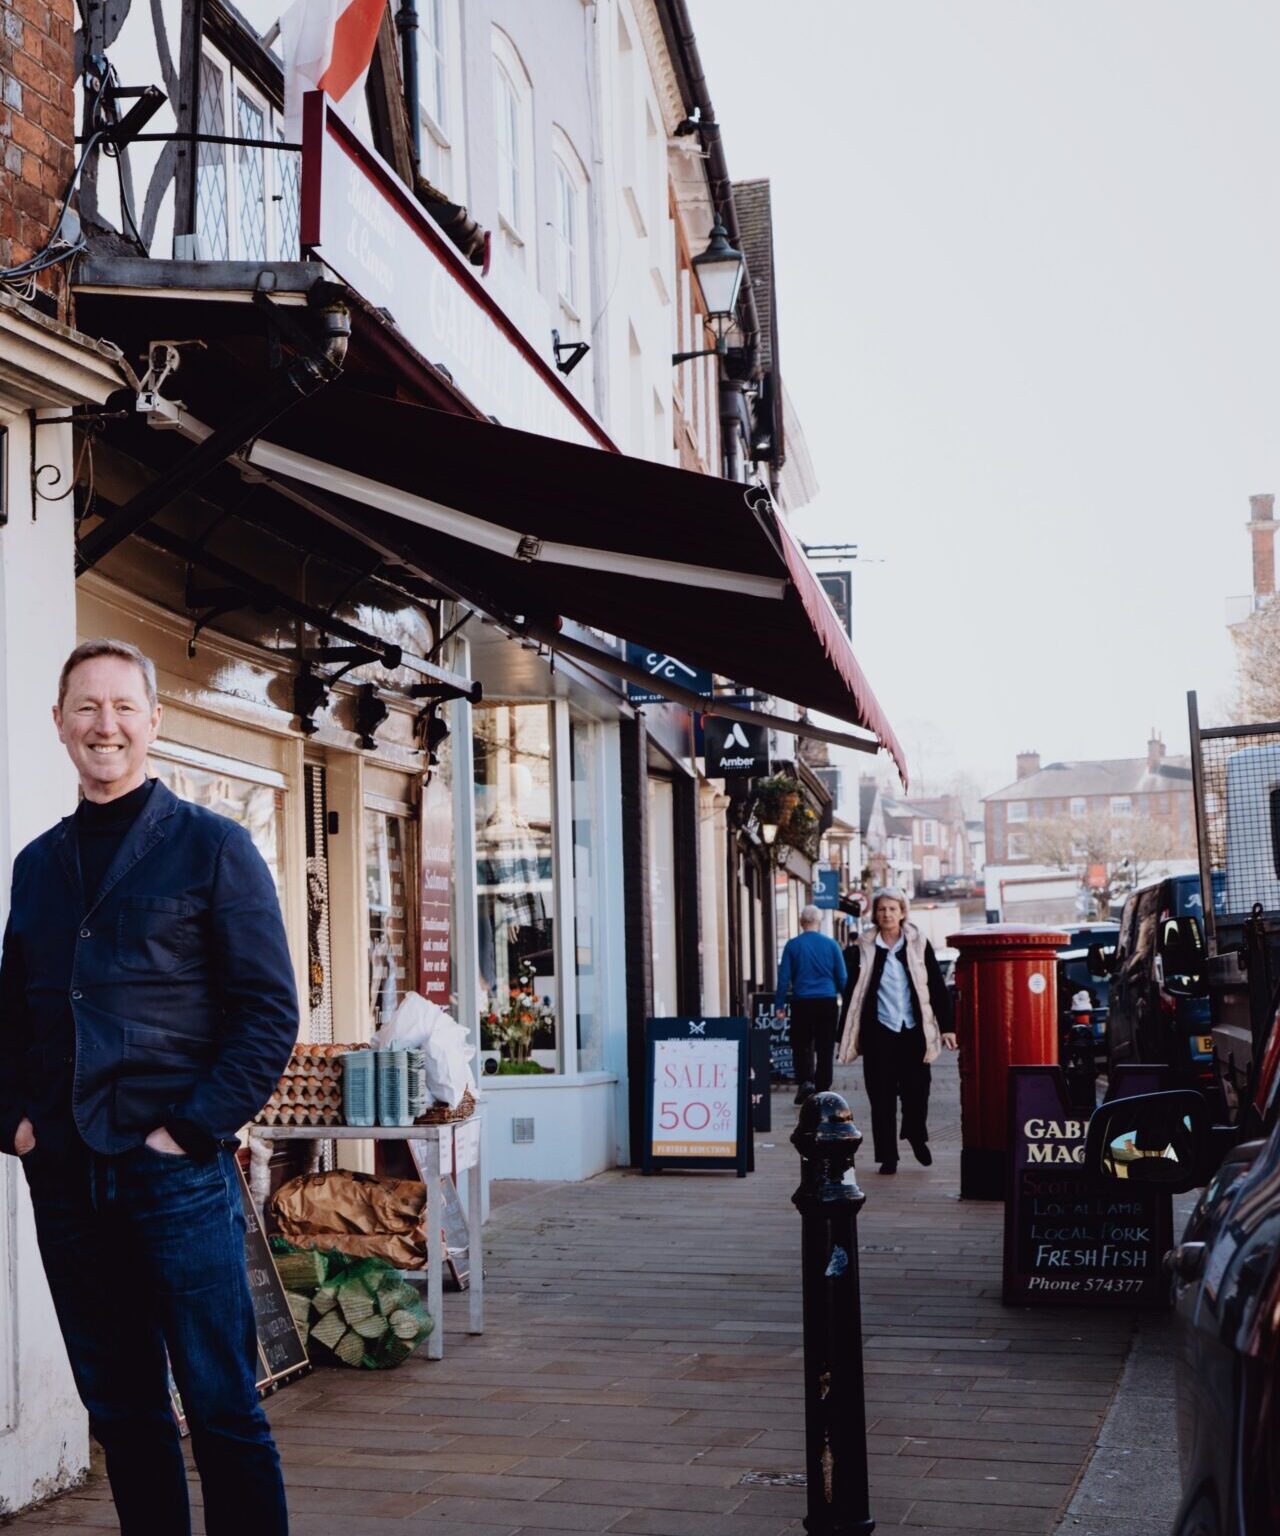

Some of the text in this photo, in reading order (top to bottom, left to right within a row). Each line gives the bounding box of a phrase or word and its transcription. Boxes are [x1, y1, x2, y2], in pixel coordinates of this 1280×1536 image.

[720, 756, 755, 767] Amber
[664, 1064, 726, 1088] SALE
[659, 1101, 731, 1130] 50%
[712, 1118, 731, 1131] off
[1031, 1224, 1095, 1241] LOCAL
[1036, 1244, 1147, 1268] FRESH FISH
[1028, 1276, 1144, 1292] Phone 574377
